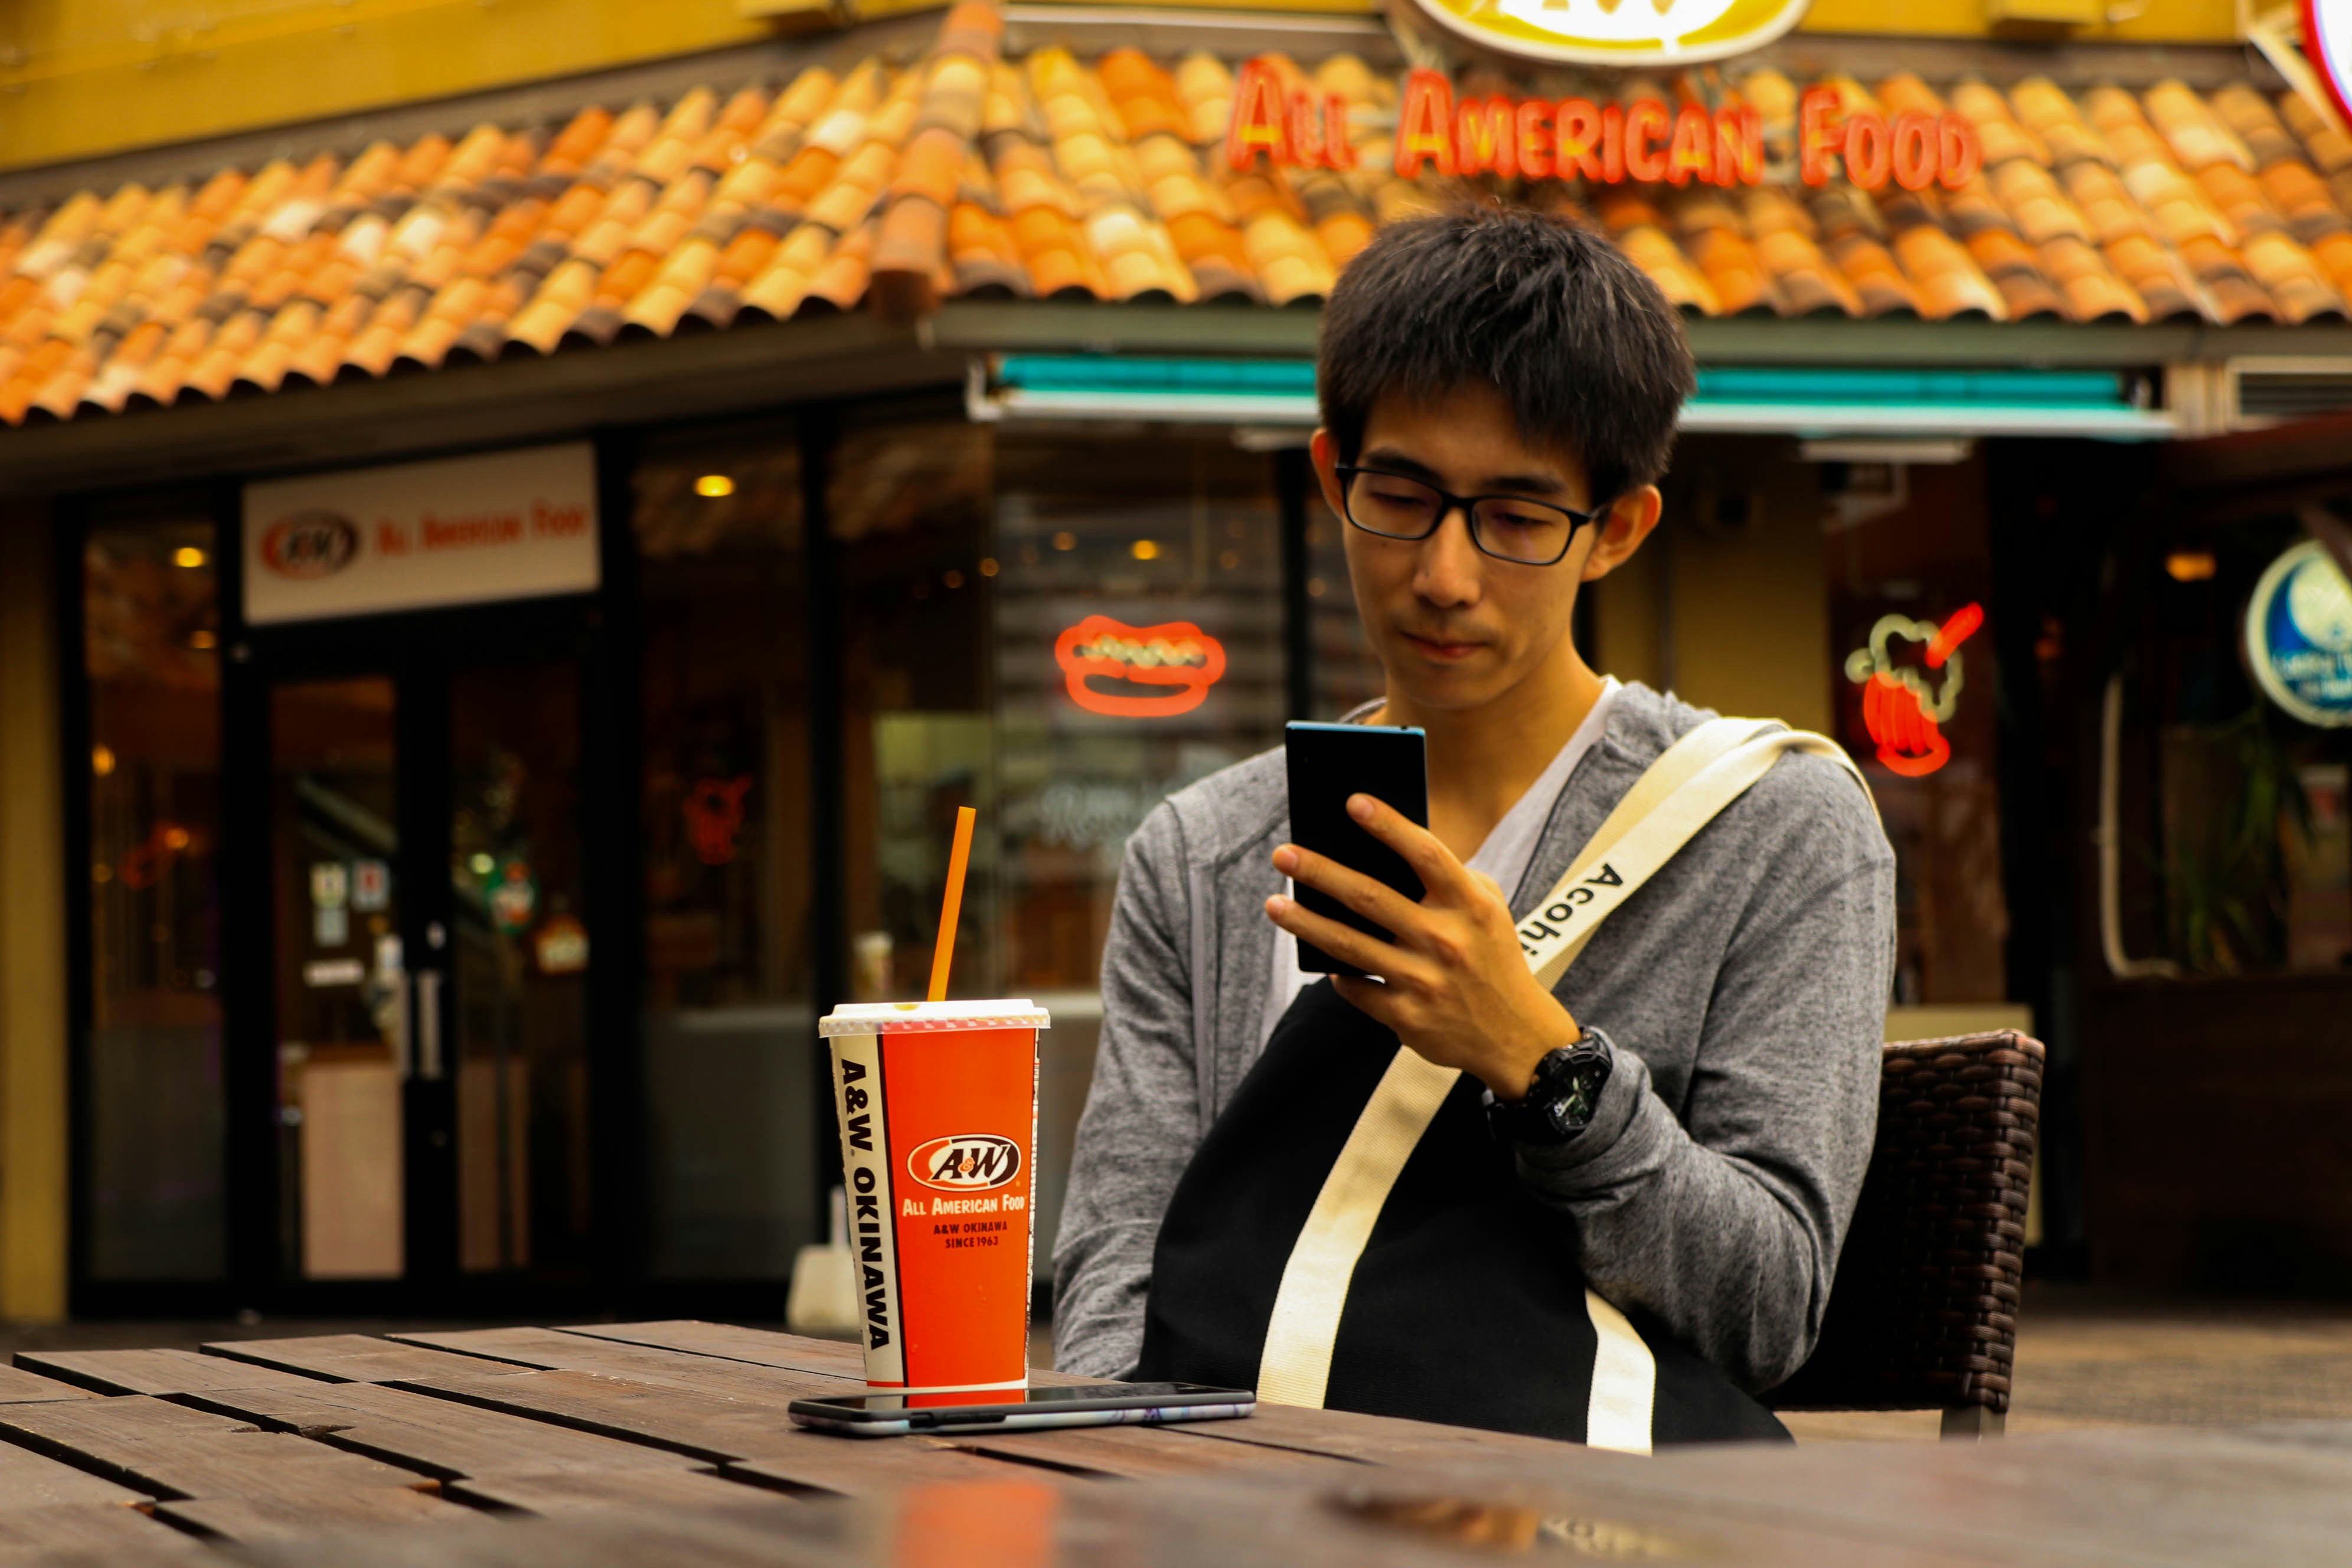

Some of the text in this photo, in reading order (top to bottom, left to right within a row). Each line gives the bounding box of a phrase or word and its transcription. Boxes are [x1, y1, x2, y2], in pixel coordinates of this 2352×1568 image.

[1393, 67, 1767, 188] AMERICAN
[1800, 84, 1984, 191] FOOD
[928, 1144, 1011, 1181] A&W
[841, 1058, 890, 1351] A&W OKINAWA
[902, 1193, 1025, 1217] ALL AMERICAN FOOD
[933, 1220, 1008, 1235] A&W OKINAWA
[945, 1236, 999, 1249] SINCE 1963
